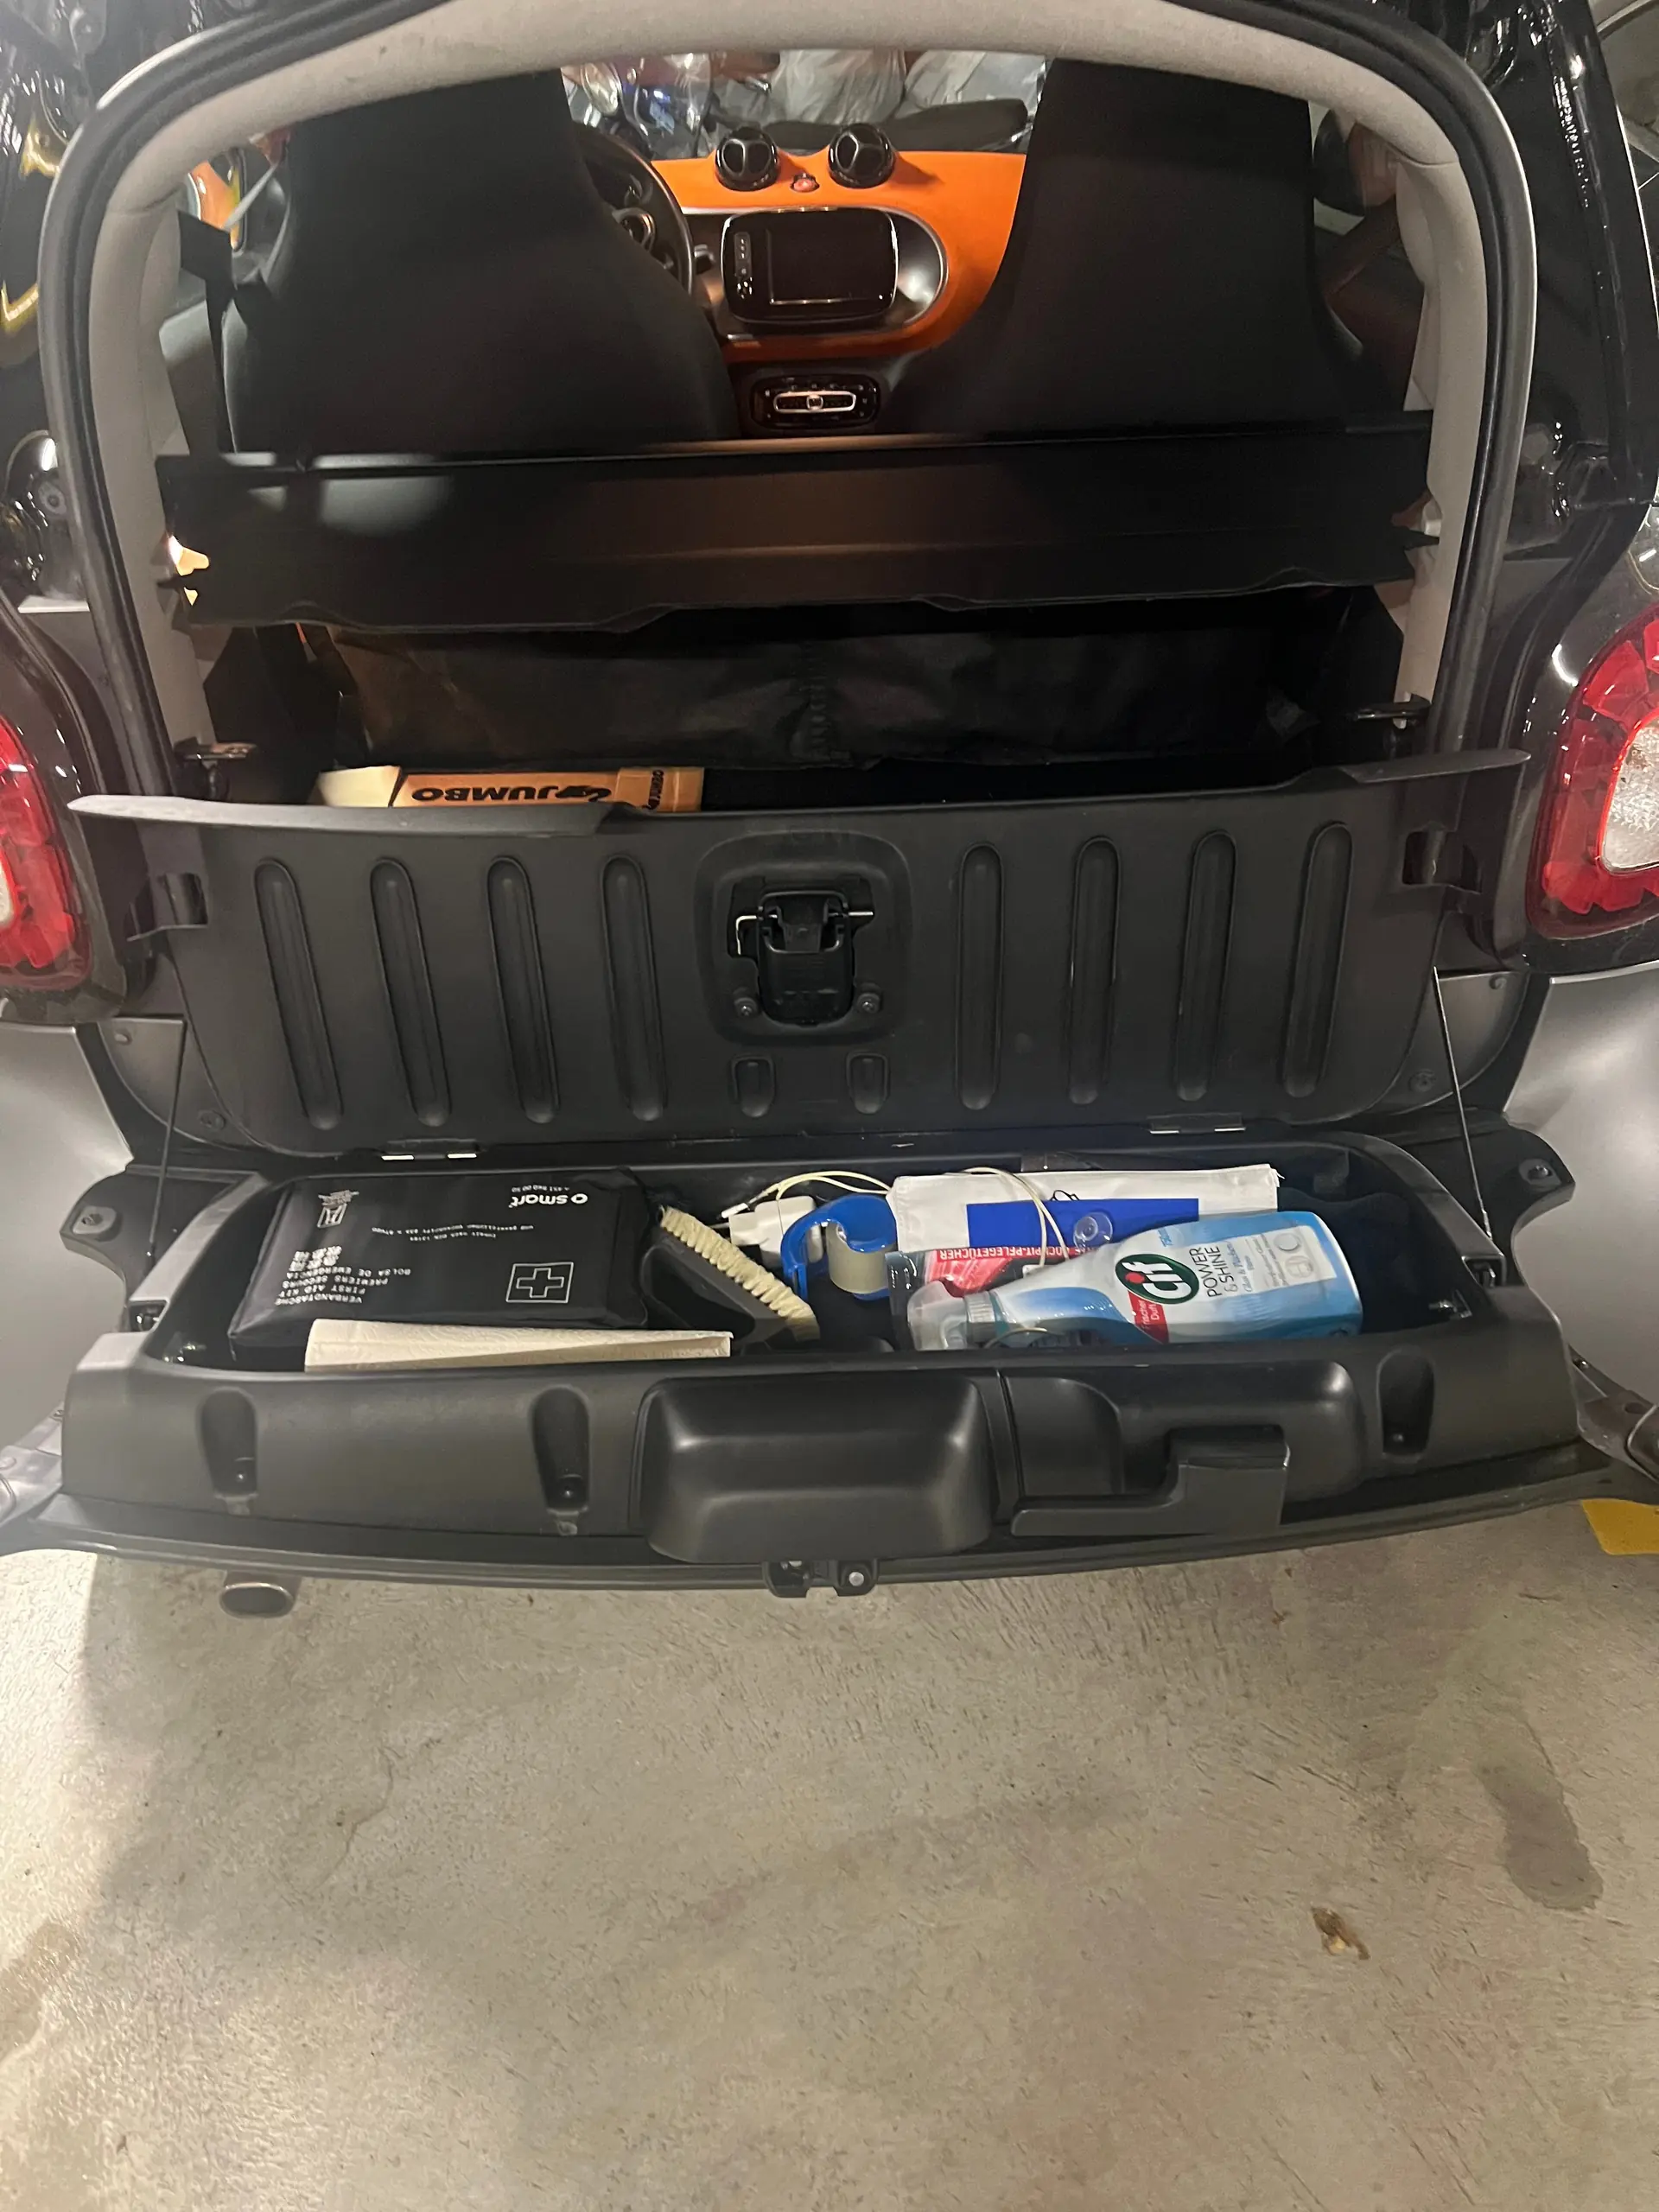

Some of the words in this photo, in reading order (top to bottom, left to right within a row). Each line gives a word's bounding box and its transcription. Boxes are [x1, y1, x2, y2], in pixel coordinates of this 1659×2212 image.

[412, 785, 559, 803] JUMBO
[511, 1194, 569, 1208] smart
[939, 1246, 1070, 1260] OCPIT-PFLEGETÜCHER
[287, 1267, 353, 1279] EMERGENCIA
[378, 1268, 412, 1277] BOLSA
[1189, 1247, 1223, 1297] POWER
[282, 1275, 328, 1289] SECOURS
[334, 1275, 389, 1287] PREMIERS
[278, 1288, 300, 1298] KIT
[304, 1284, 326, 1294] AID
[331, 1284, 366, 1295] FIRST
[275, 1293, 363, 1306] VERBANDTASCHE
